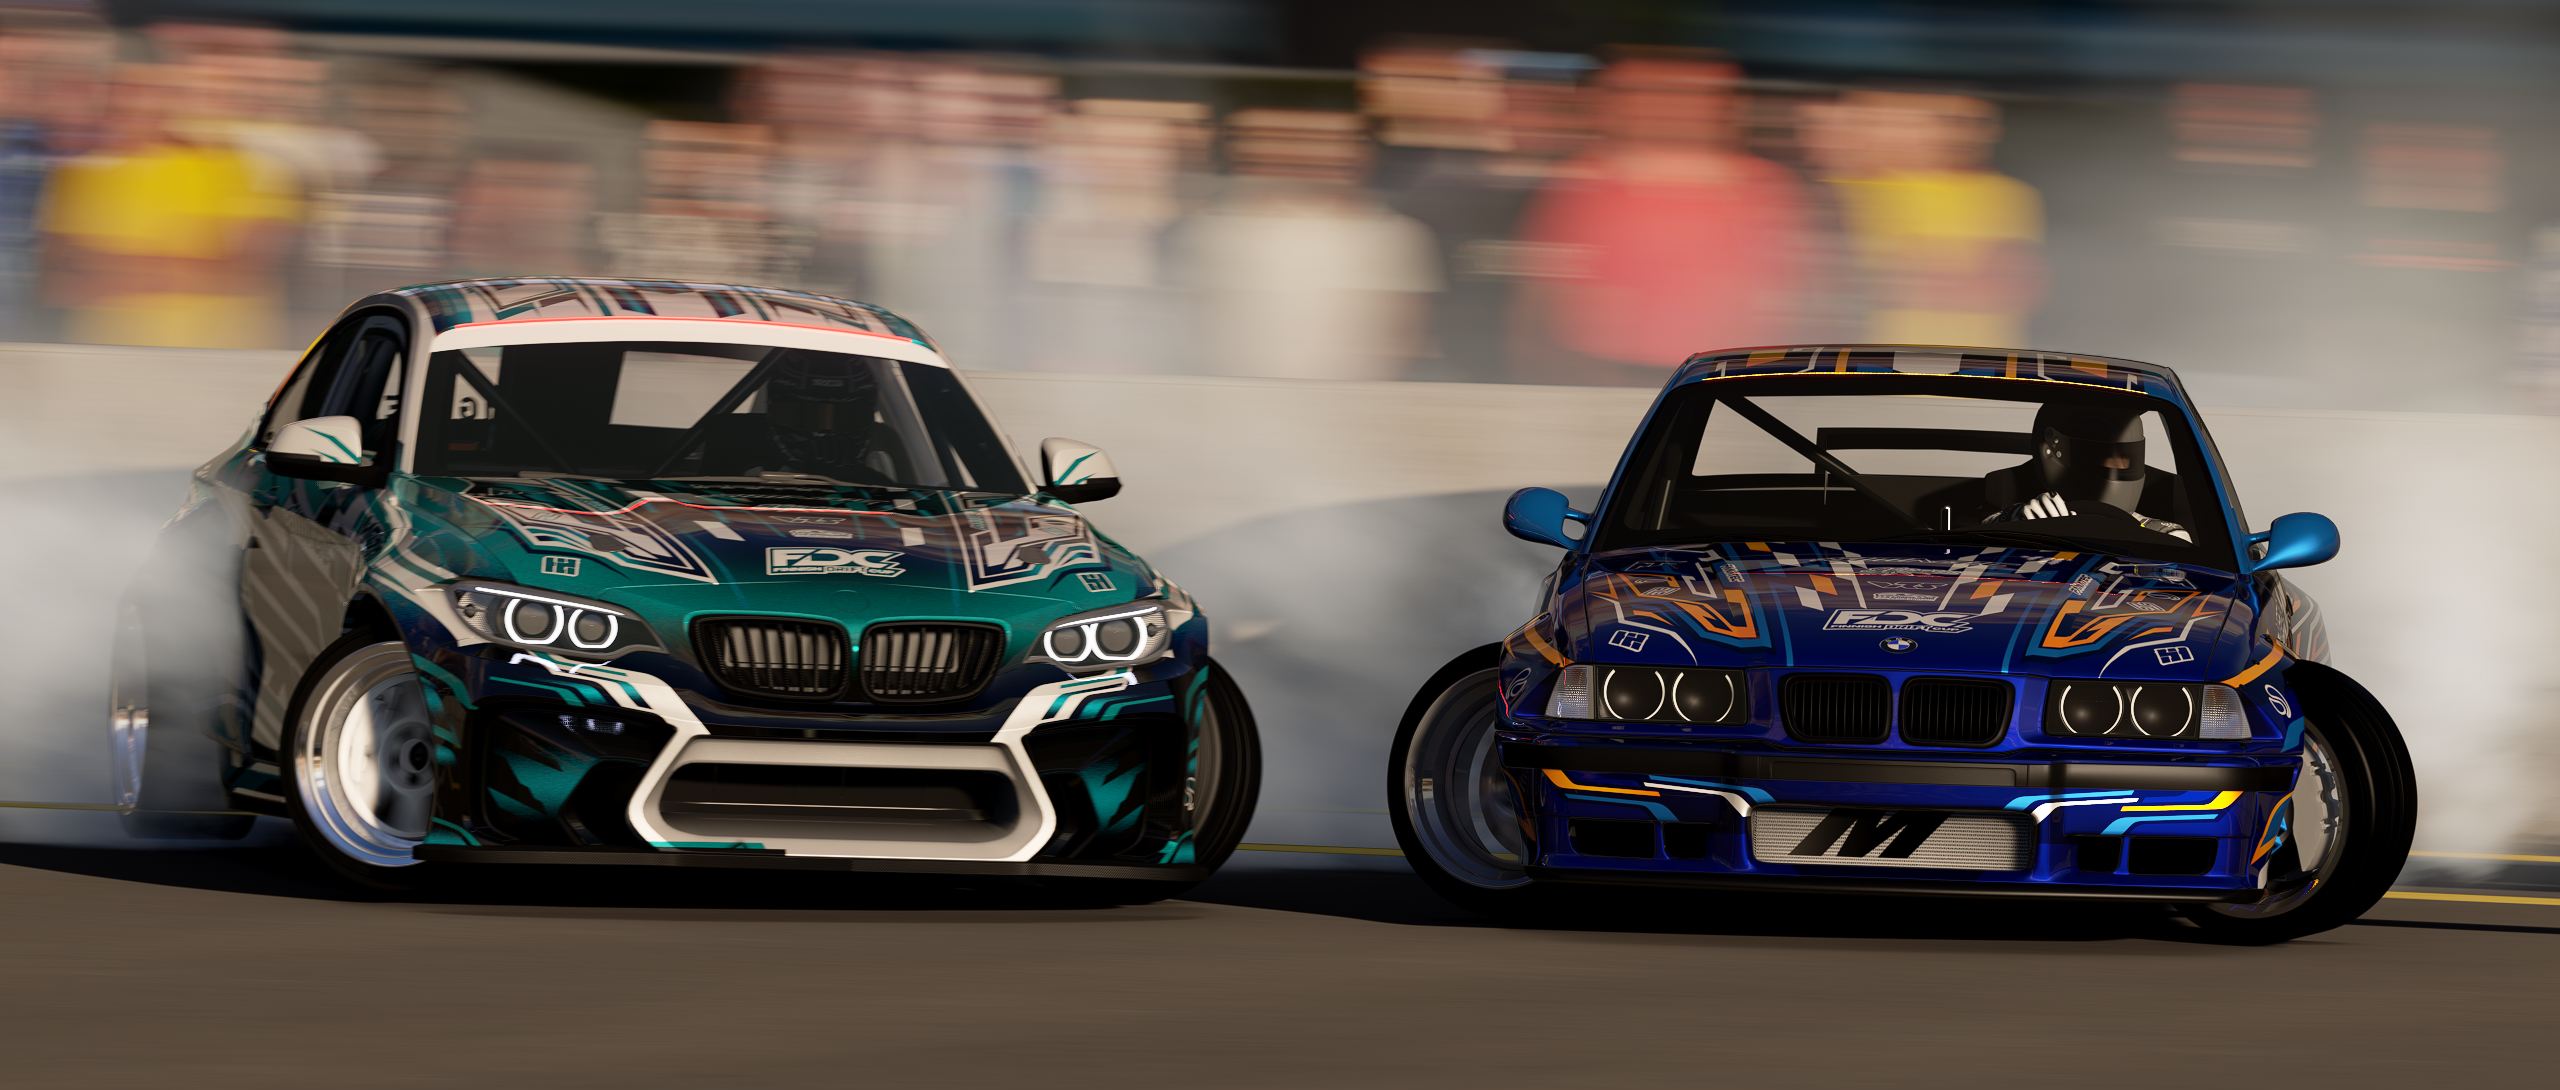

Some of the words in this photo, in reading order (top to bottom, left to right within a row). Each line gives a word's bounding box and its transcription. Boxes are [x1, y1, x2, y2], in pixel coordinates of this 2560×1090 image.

[772, 549, 895, 568] FDC
[1833, 611, 1967, 626] FDC
[1787, 808, 1951, 859] M
